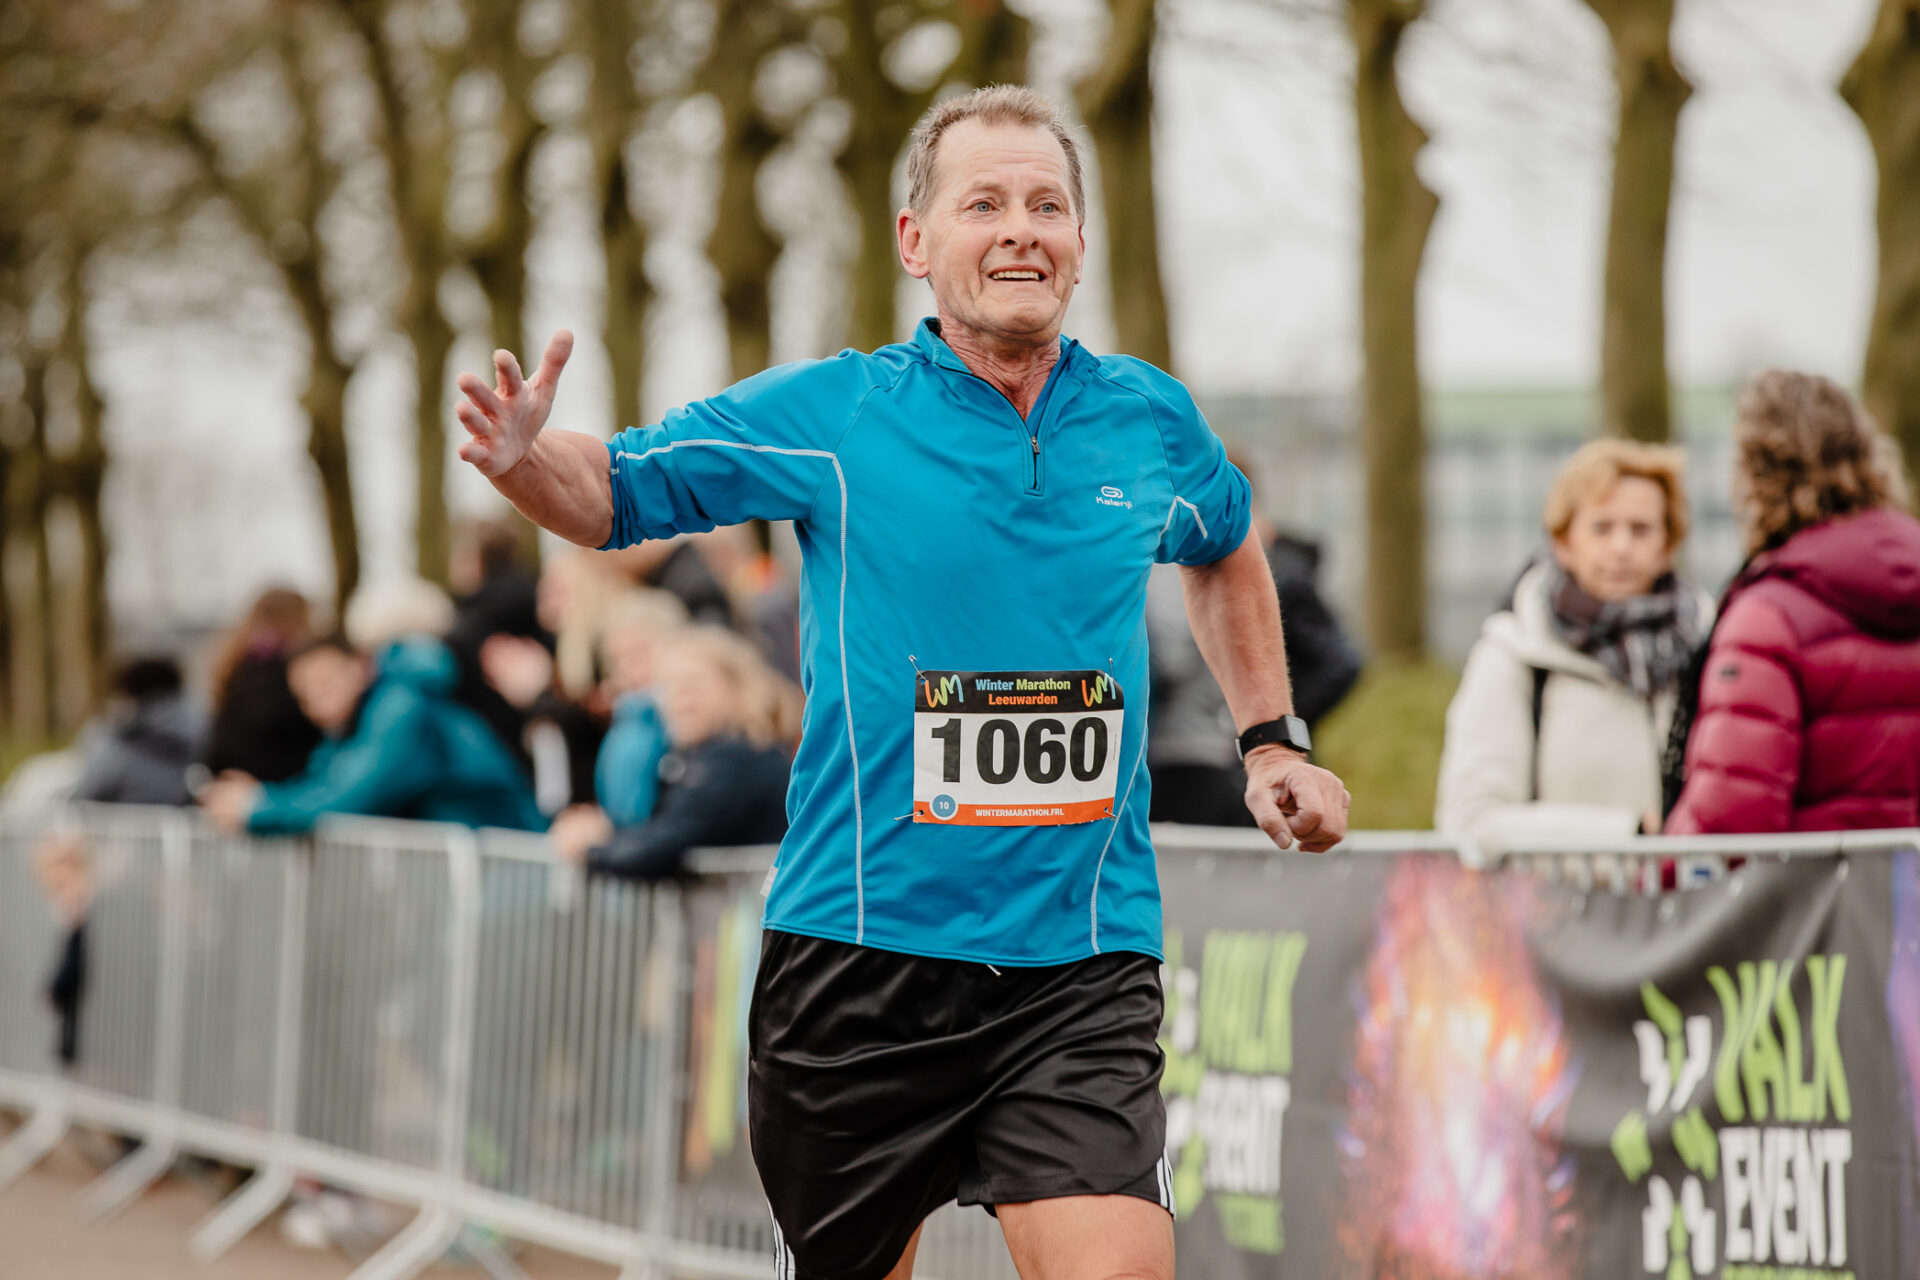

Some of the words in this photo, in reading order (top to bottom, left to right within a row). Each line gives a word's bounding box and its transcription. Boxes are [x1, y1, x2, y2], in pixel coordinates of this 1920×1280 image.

[975, 679, 1014, 691] Winter
[1016, 678, 1071, 691] Marathon
[988, 693, 1058, 706] Leeuwarden
[931, 717, 1108, 785] 1060
[939, 801, 949, 811] 10
[975, 808, 1065, 818] WINTERMARATHON.FRL
[1719, 1127, 1852, 1266] EVENT
